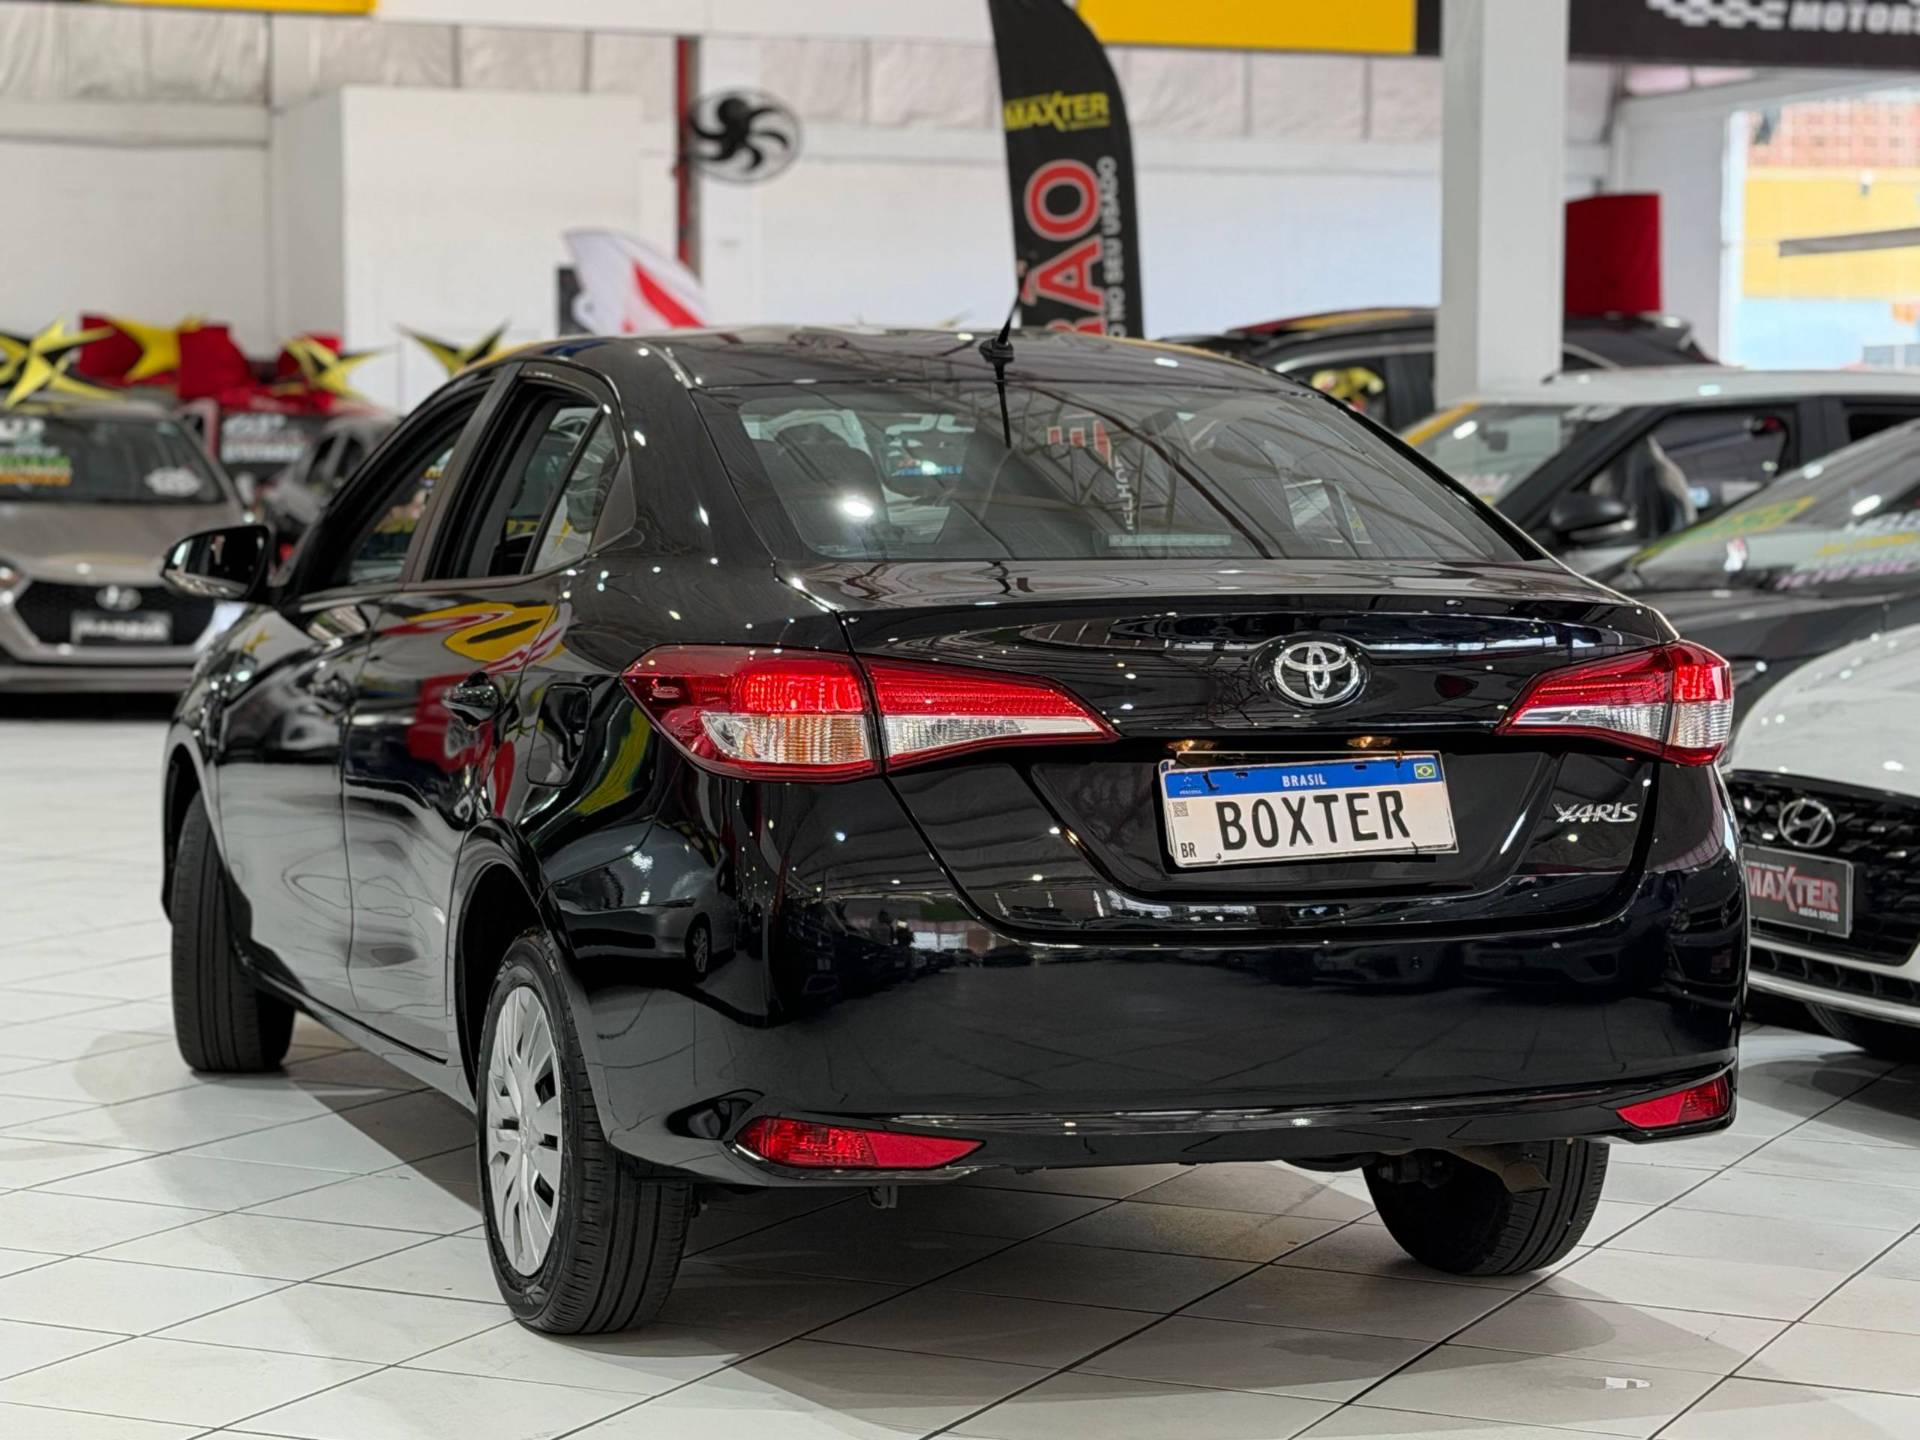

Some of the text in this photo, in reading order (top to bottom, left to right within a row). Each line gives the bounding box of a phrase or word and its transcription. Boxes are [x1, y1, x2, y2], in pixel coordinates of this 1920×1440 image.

[1004, 91, 1109, 131] MAXTER
[1096, 155, 1122, 236] USADO
[1102, 238, 1124, 285] SEU
[1281, 773, 1327, 788] BRASIL
[1215, 790, 1411, 851] BOXTER
[1552, 802, 1638, 823] YARIS
[1180, 842, 1197, 859] BR
[1744, 864, 1840, 912] MAXTER
